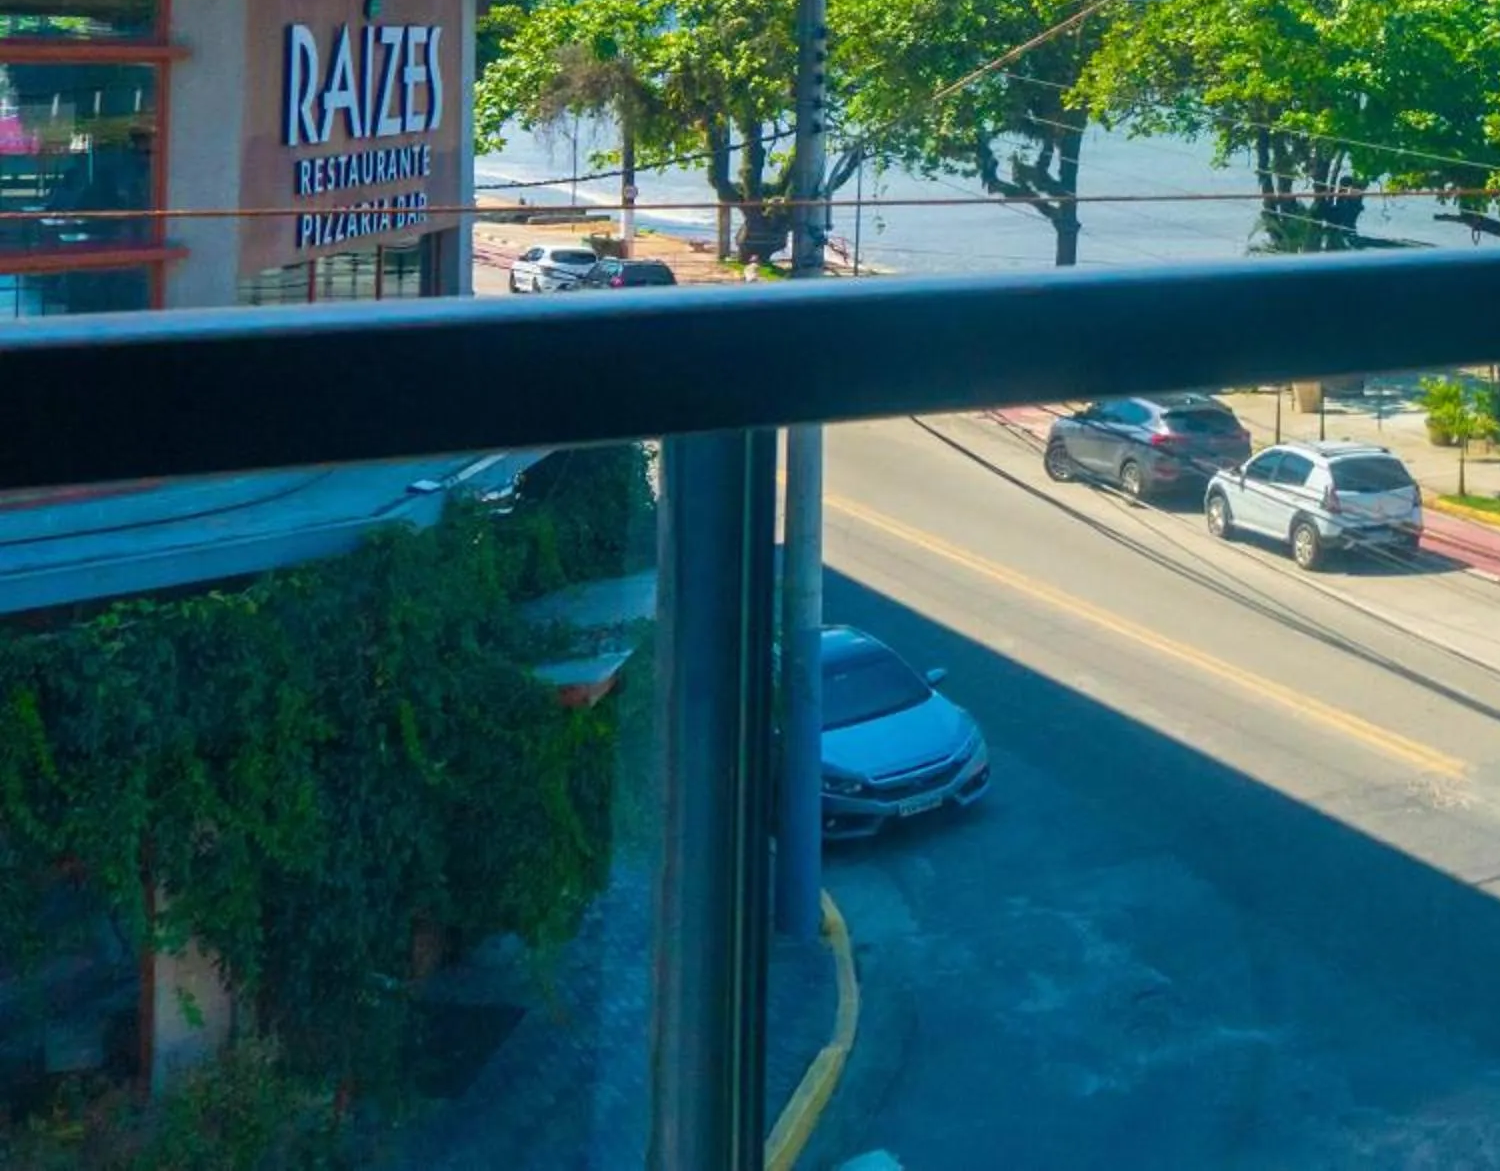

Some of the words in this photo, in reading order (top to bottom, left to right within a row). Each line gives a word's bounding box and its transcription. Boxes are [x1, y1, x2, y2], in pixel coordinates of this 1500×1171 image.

[298, 145, 432, 195] RESTAURANTE
[298, 200, 390, 249] PIZZARIA
[396, 192, 428, 228] BAR
